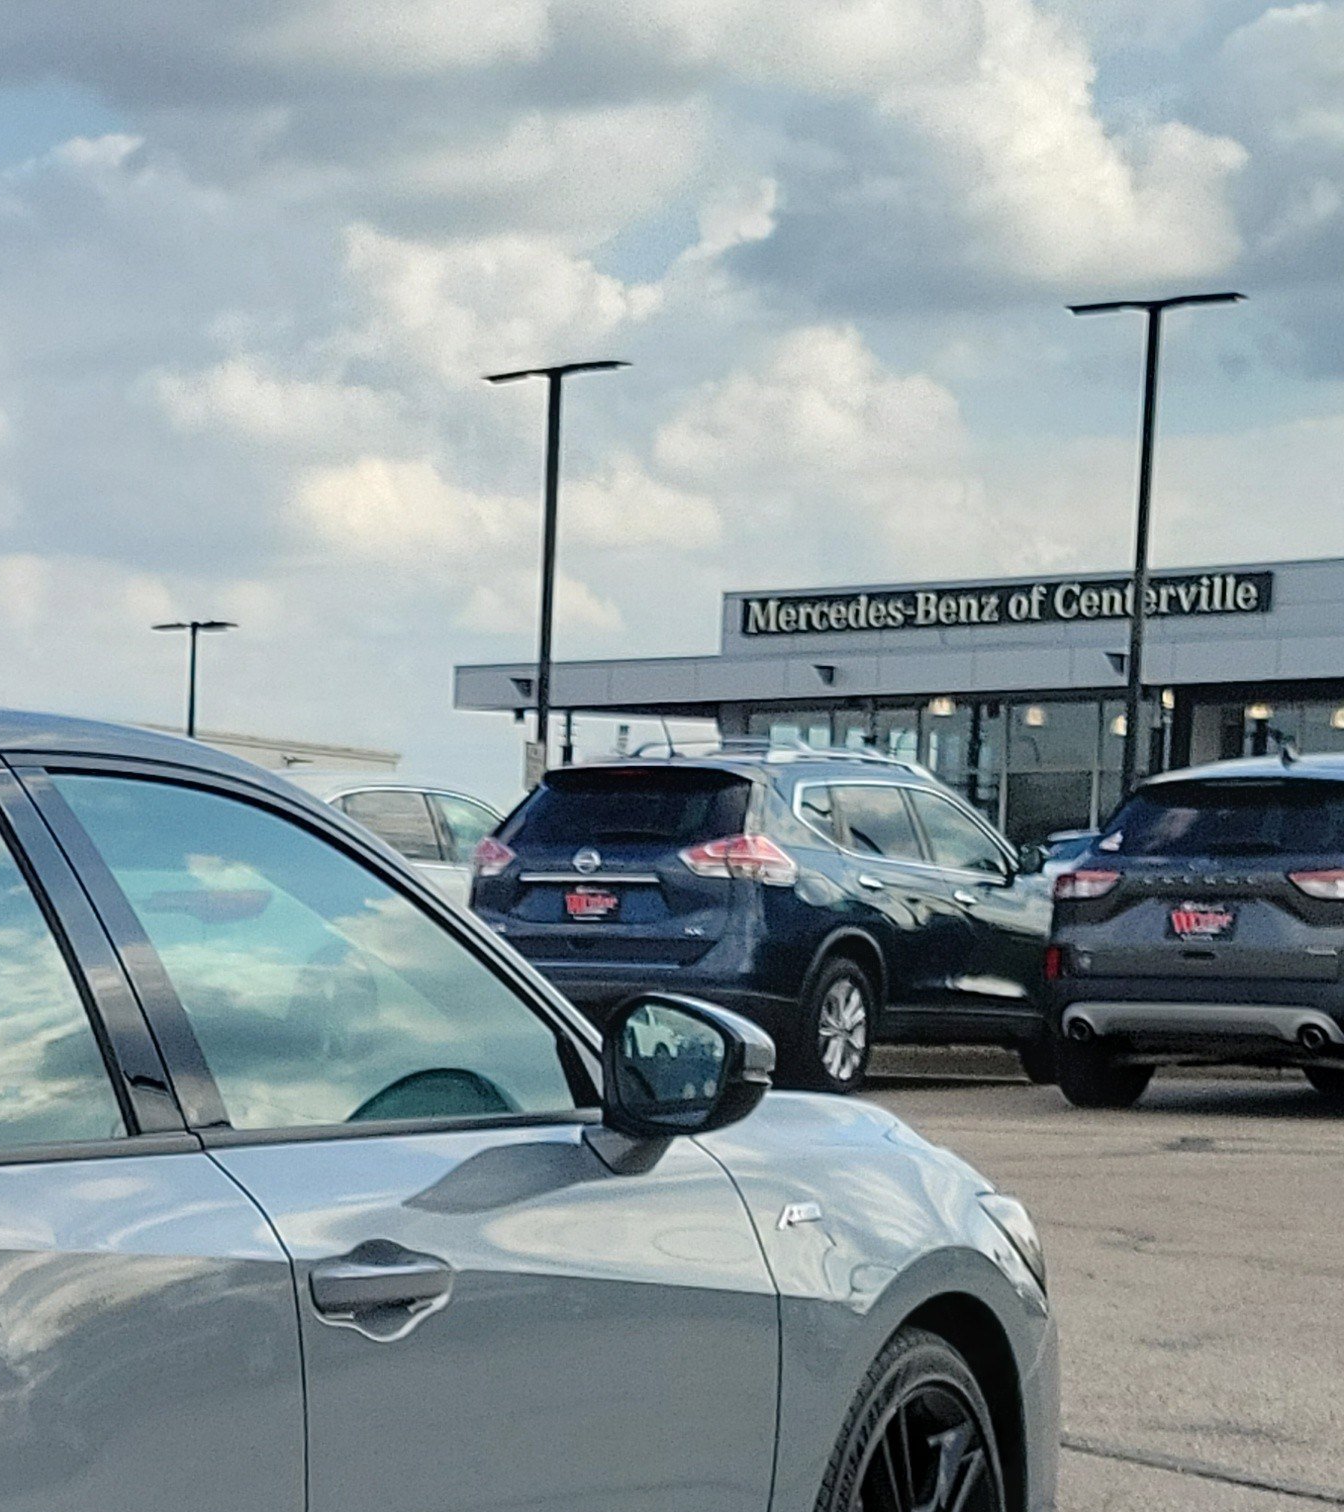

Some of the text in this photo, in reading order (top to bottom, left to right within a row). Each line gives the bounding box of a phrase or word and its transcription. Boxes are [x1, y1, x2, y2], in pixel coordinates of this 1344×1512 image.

[748, 574, 1258, 634] Mercedes-Benz of Centerville
